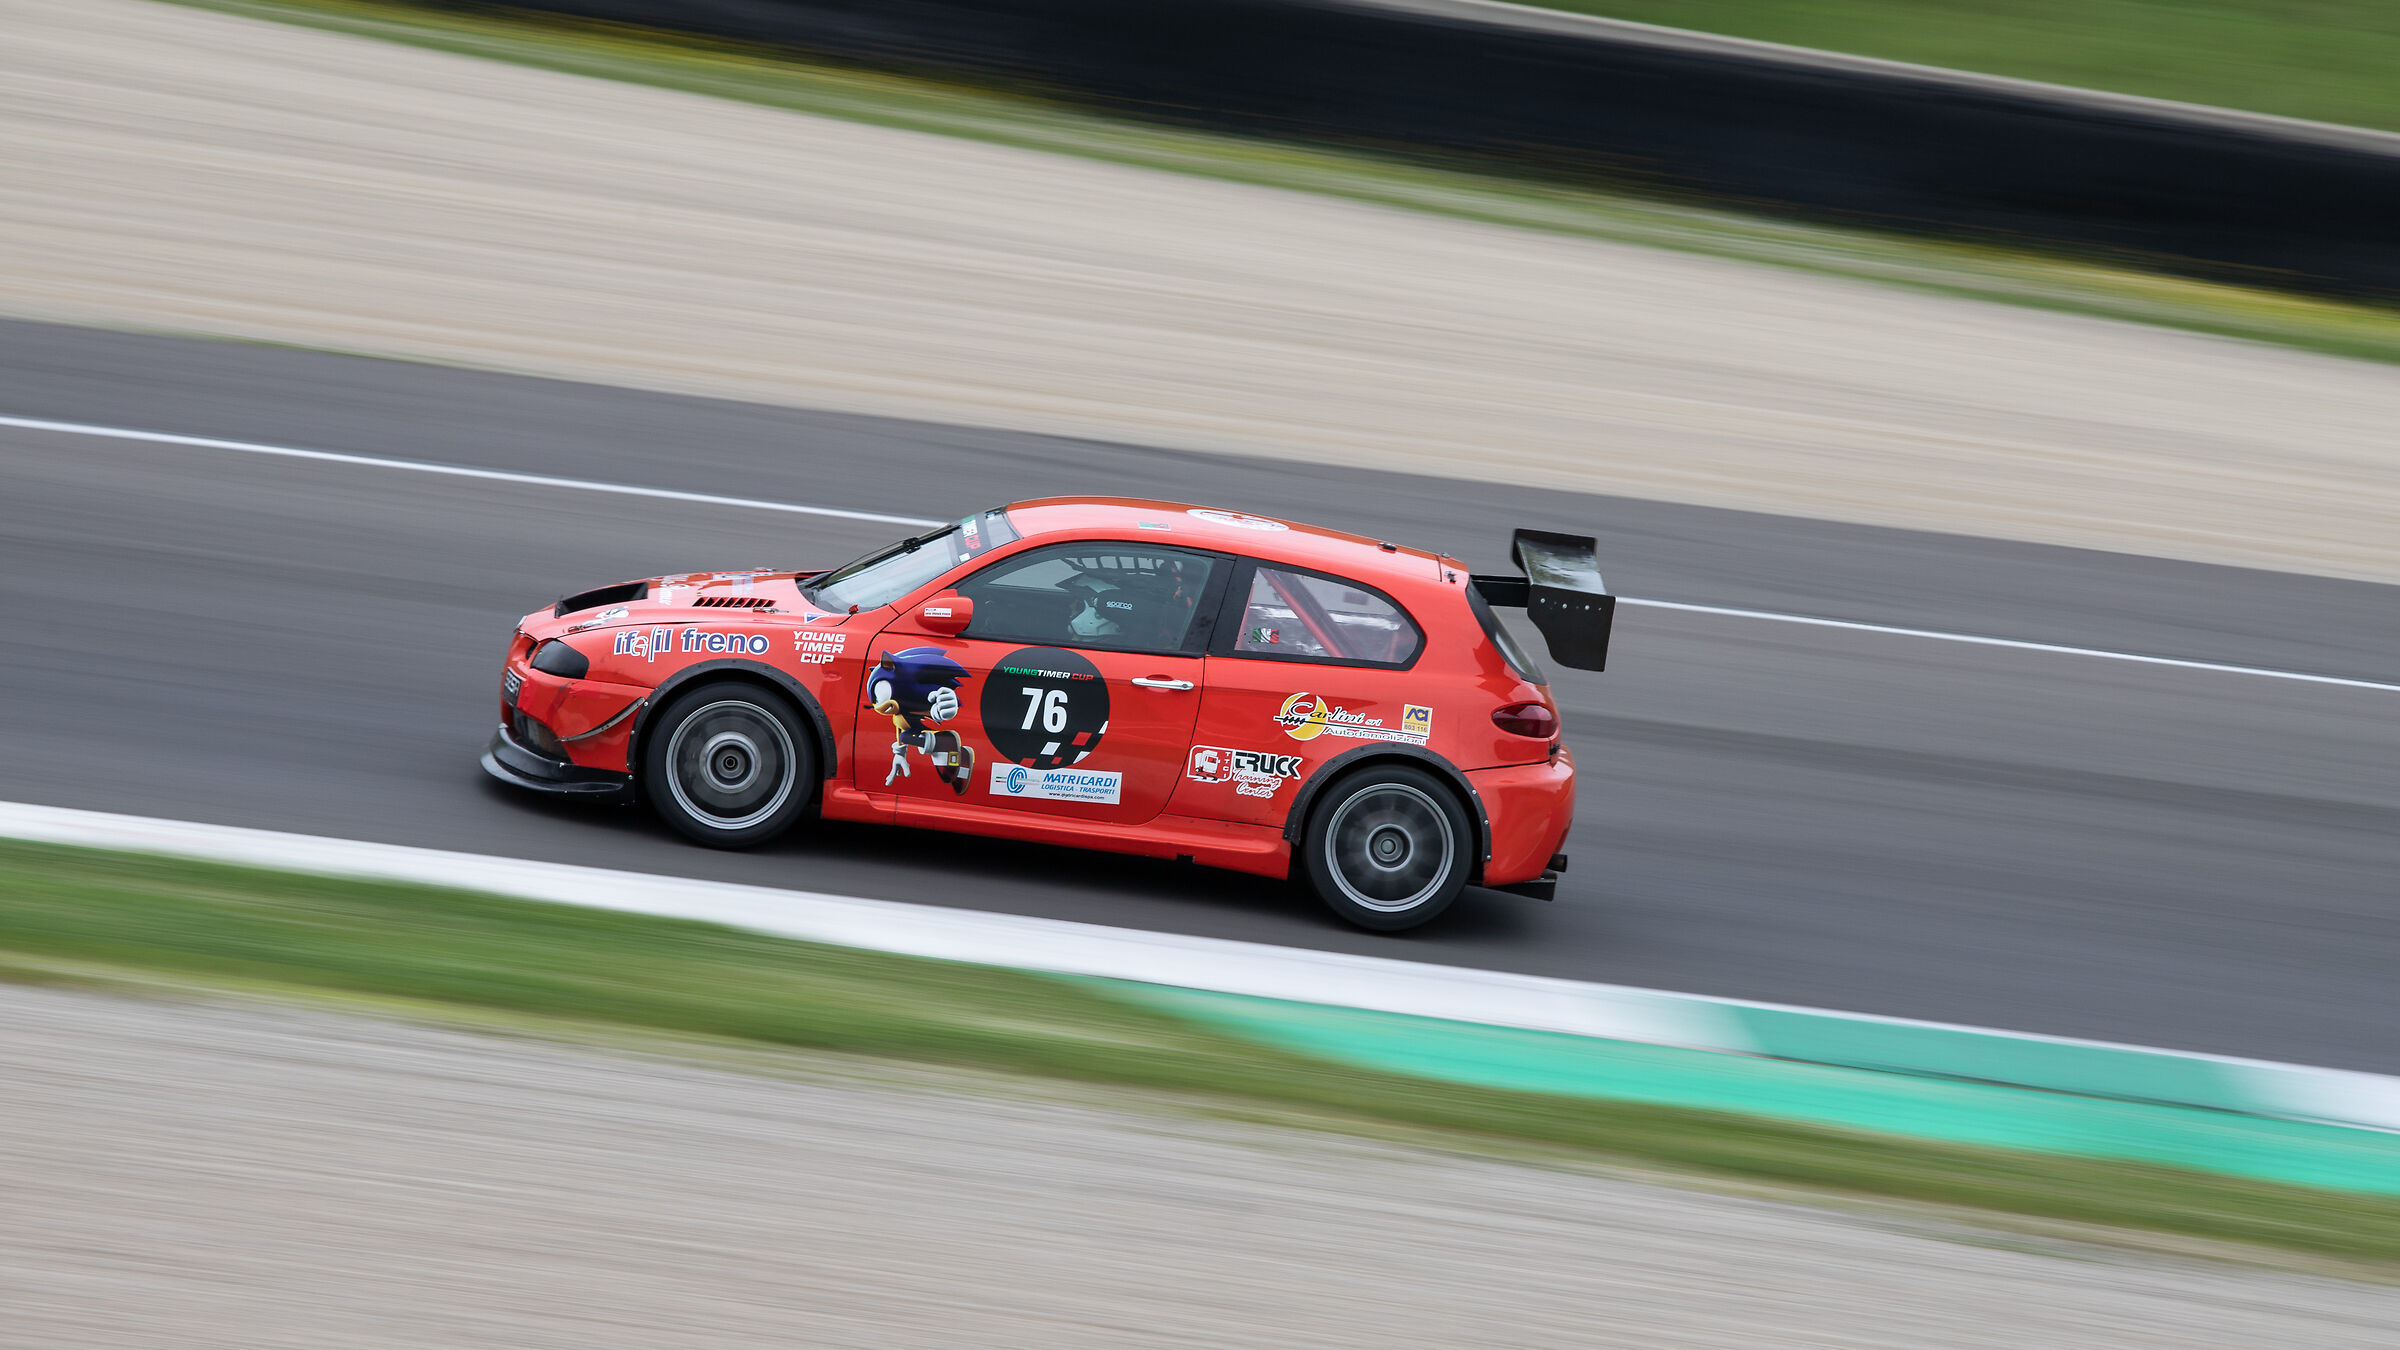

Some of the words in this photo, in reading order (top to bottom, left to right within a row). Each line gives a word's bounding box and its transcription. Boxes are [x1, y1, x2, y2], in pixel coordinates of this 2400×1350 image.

[681, 628, 769, 654] freno
[793, 631, 847, 643] YOUNG
[794, 641, 845, 654] TIMER
[800, 653, 834, 664] CUP
[1021, 687, 1068, 733] 76
[1290, 702, 1365, 724] Carlini
[1323, 727, 1426, 745] Autodemolizioni
[1235, 751, 1301, 778] TRUCK
[1043, 774, 1117, 787] MATRICARDI
[1234, 768, 1281, 788] Training
[1041, 784, 1074, 792] LOGISTICA
[1079, 786, 1115, 795] TRASPORTI
[1237, 781, 1272, 797] Center
